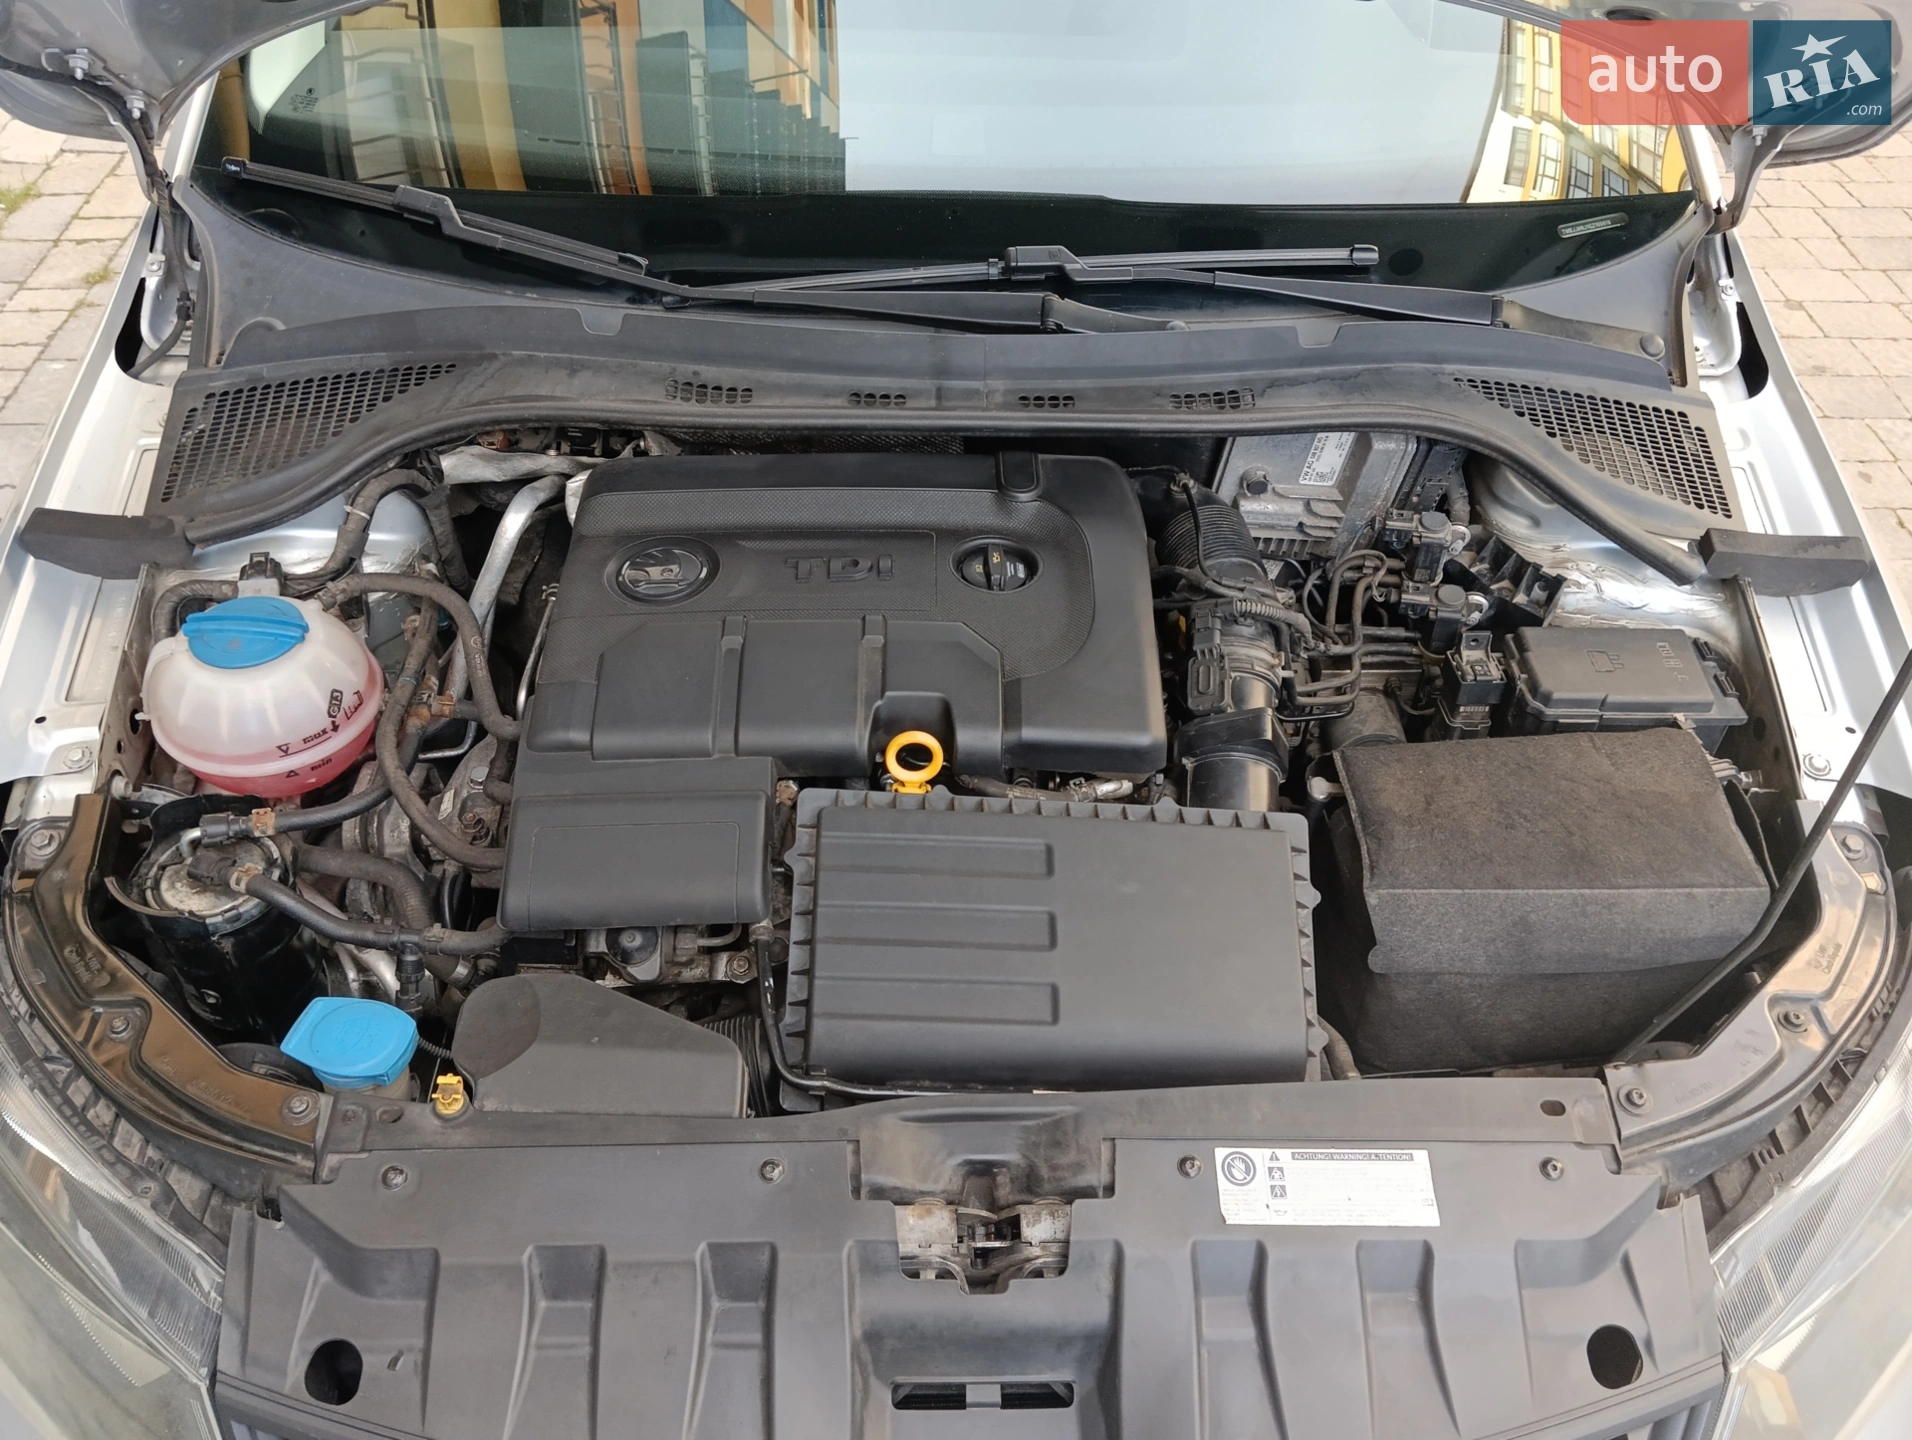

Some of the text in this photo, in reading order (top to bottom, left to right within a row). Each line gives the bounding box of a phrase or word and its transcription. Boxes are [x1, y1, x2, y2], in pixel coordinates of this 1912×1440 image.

[1300, 470, 1310, 481] VW
[785, 554, 893, 582] TDI
[329, 690, 342, 717] G13
[302, 727, 329, 745] max
[310, 758, 333, 772] min
[1294, 1152, 1332, 1161] ACHTUNG!
[1333, 1152, 1370, 1161] WARNING!
